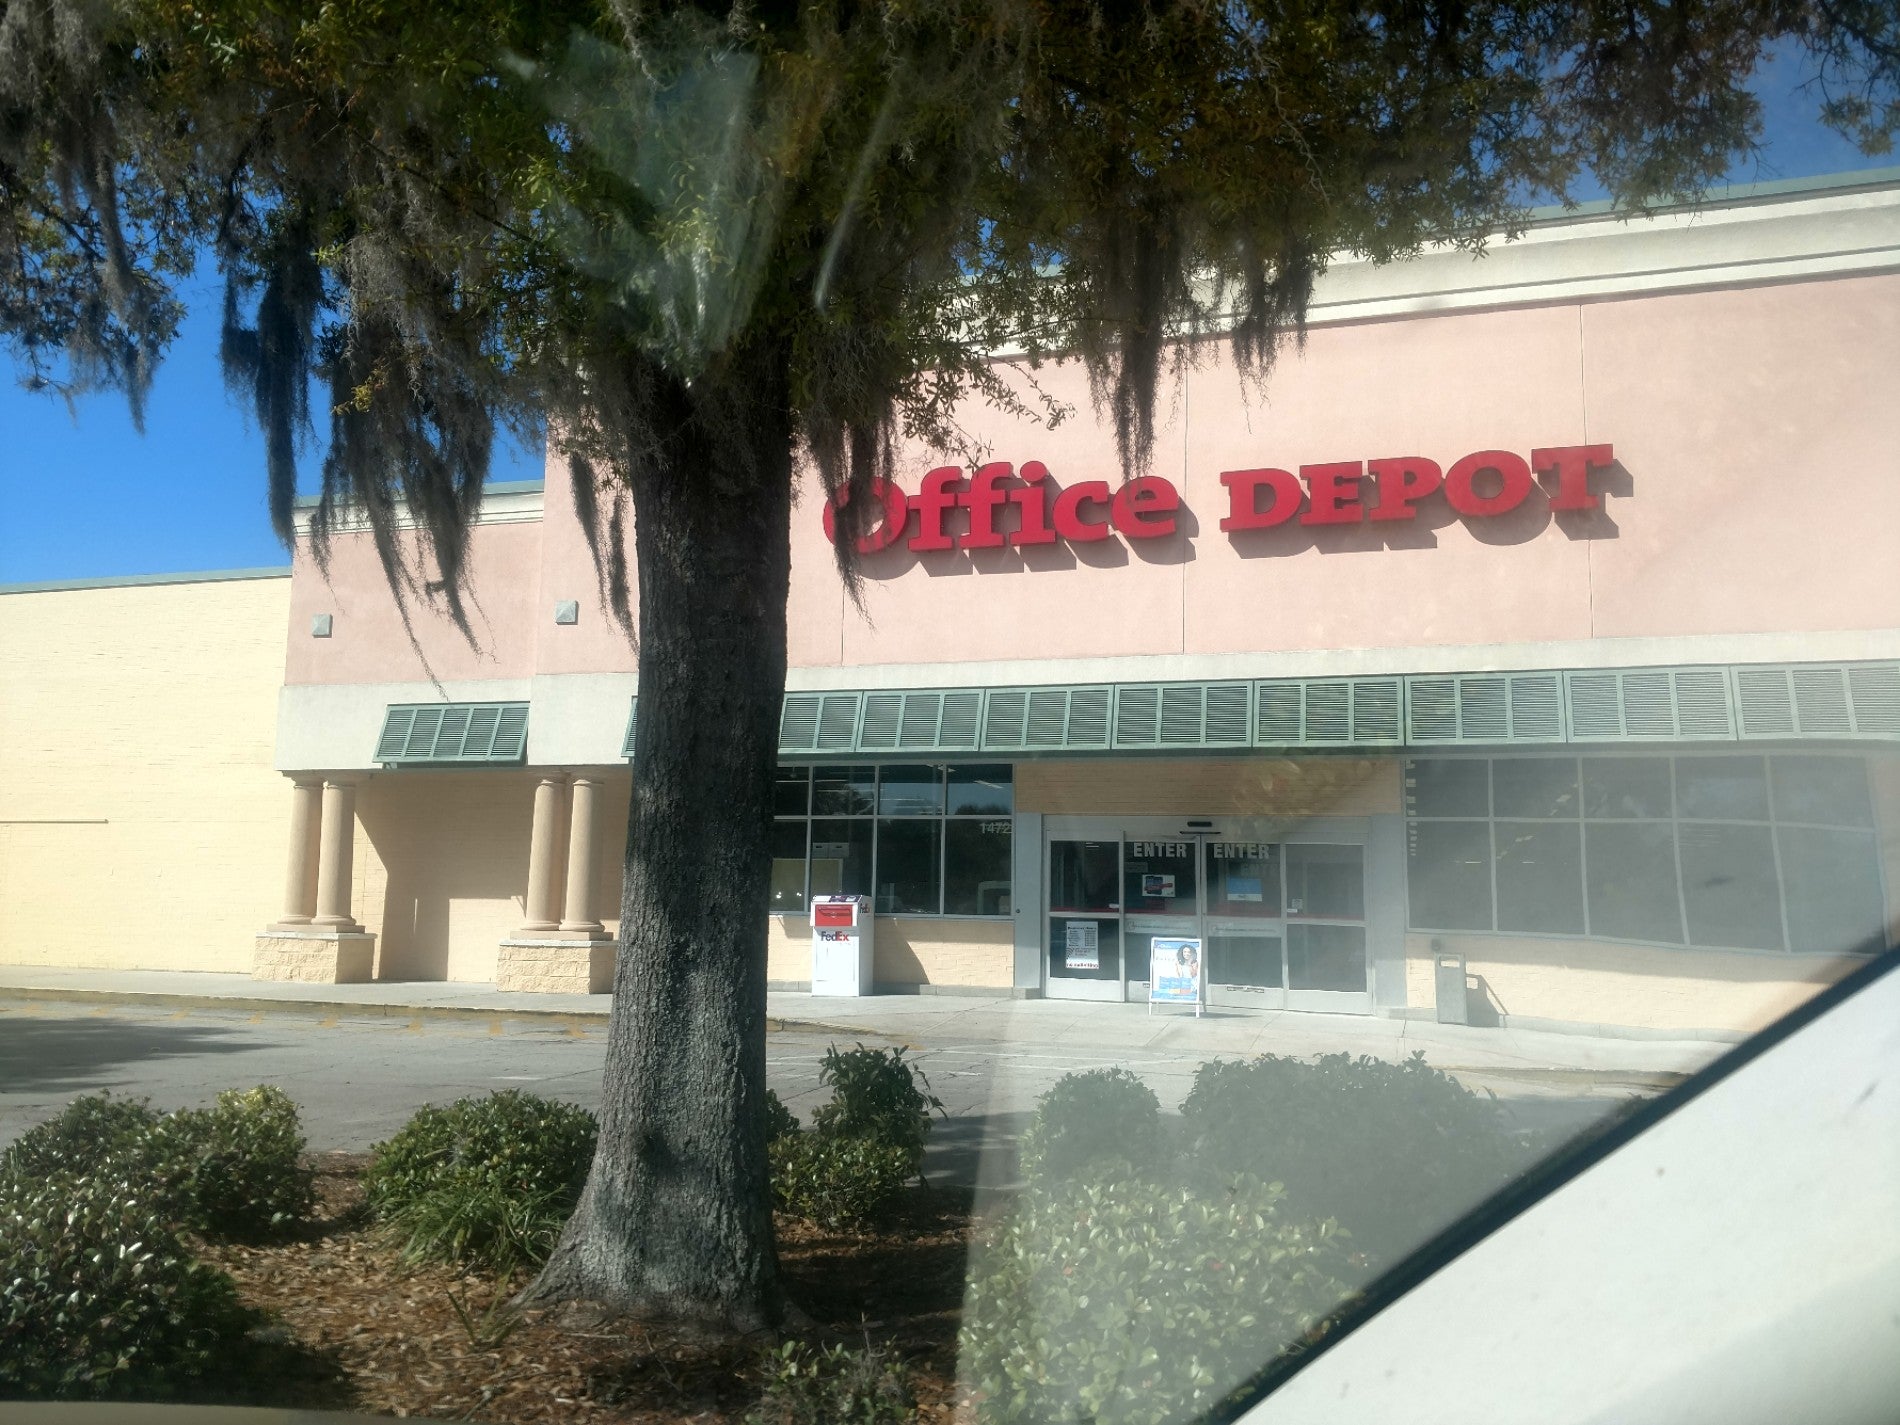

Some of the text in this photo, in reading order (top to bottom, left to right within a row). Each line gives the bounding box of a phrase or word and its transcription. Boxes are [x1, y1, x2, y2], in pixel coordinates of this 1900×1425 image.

[822, 444, 1614, 554] Office DEPOT
[1133, 842, 1187, 858] ENTER
[1213, 843, 1270, 860] ENTER
[820, 930, 850, 942] FedEx
